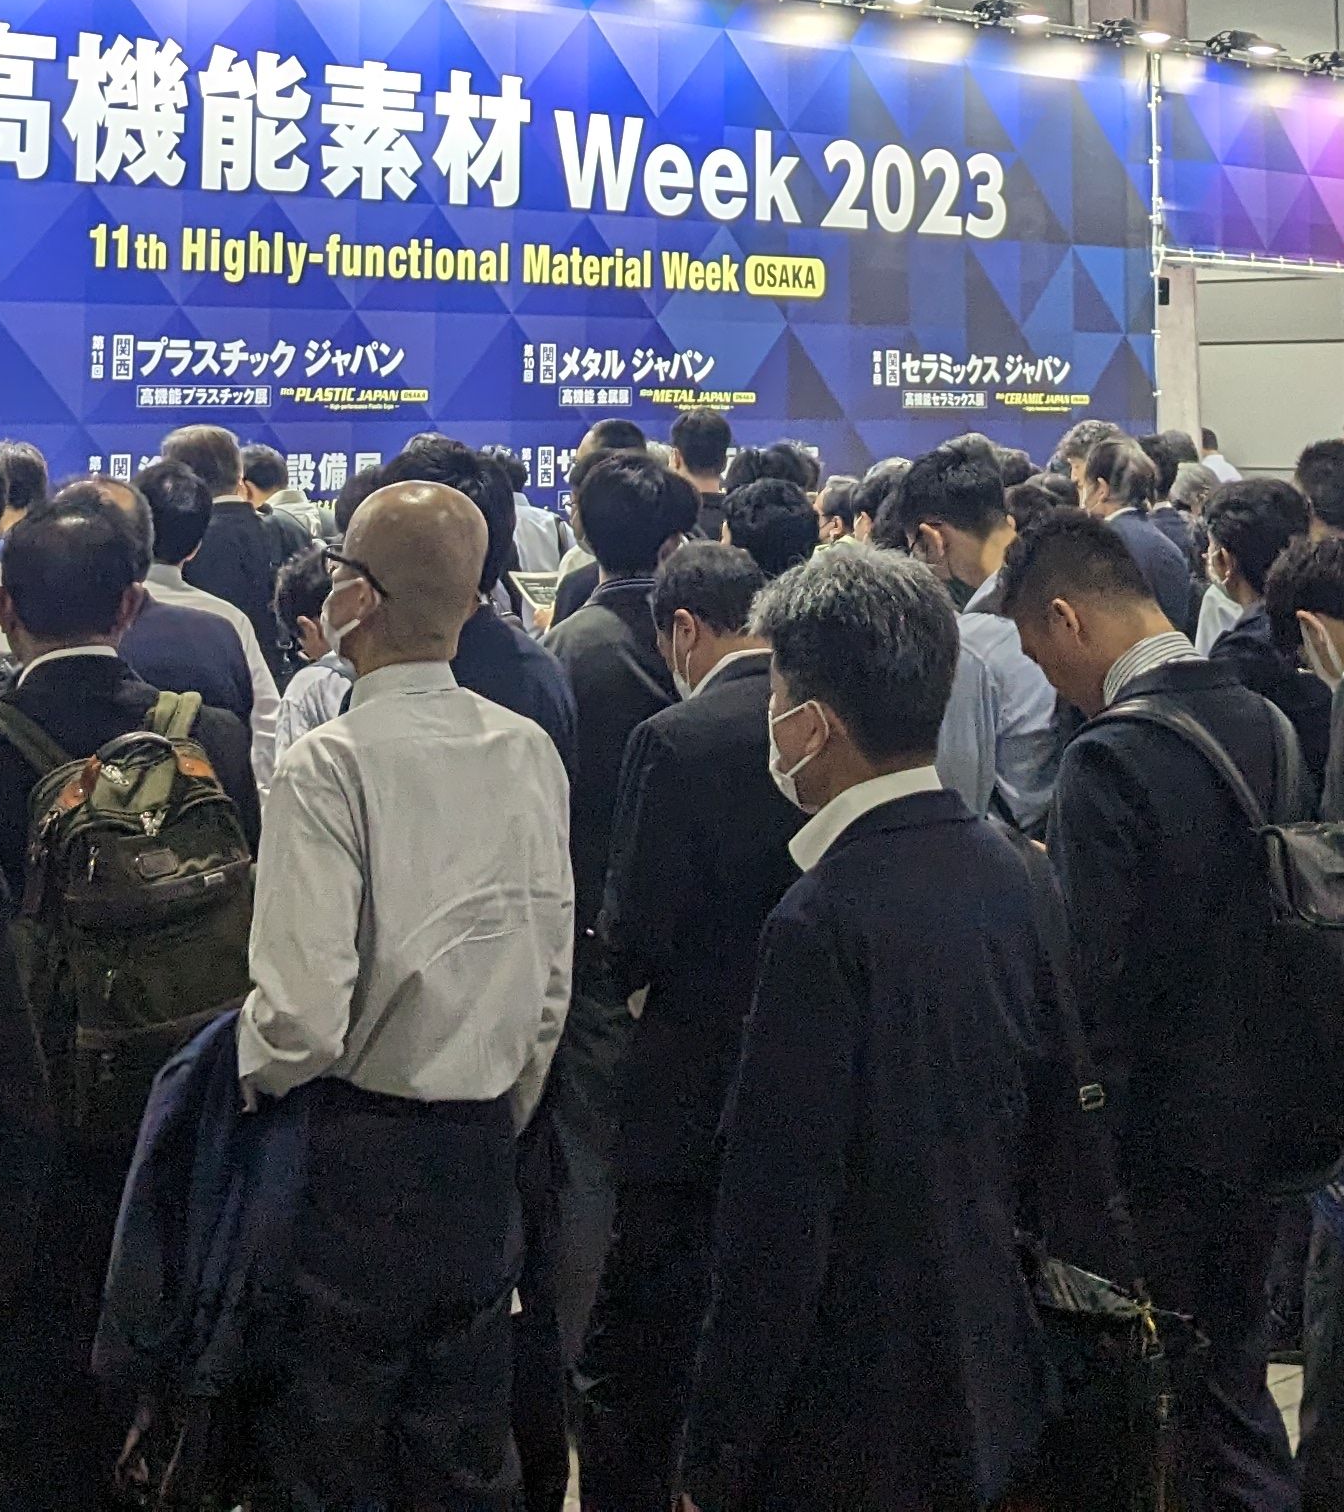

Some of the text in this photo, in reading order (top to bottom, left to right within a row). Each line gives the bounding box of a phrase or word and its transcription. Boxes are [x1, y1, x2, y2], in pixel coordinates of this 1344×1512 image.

[553, 108, 803, 223] Week
[819, 139, 1008, 240] 2023
[89, 223, 817, 292] 11th Highly-functional Material Week OSAKA
[116, 338, 131, 377] 関西
[137, 336, 405, 378] プラスチック ジャパン
[542, 346, 554, 381] 関西
[558, 346, 715, 383] メタル ジャパン
[901, 353, 1071, 385] セラミックス ジャパン
[140, 387, 268, 406] 高機能プラスチック展
[295, 387, 356, 402] PLASTIC
[357, 390, 399, 402] JAPAN
[652, 389, 696, 402] METAL
[697, 391, 732, 402] JAPAN
[541, 449, 552, 482] 関西
